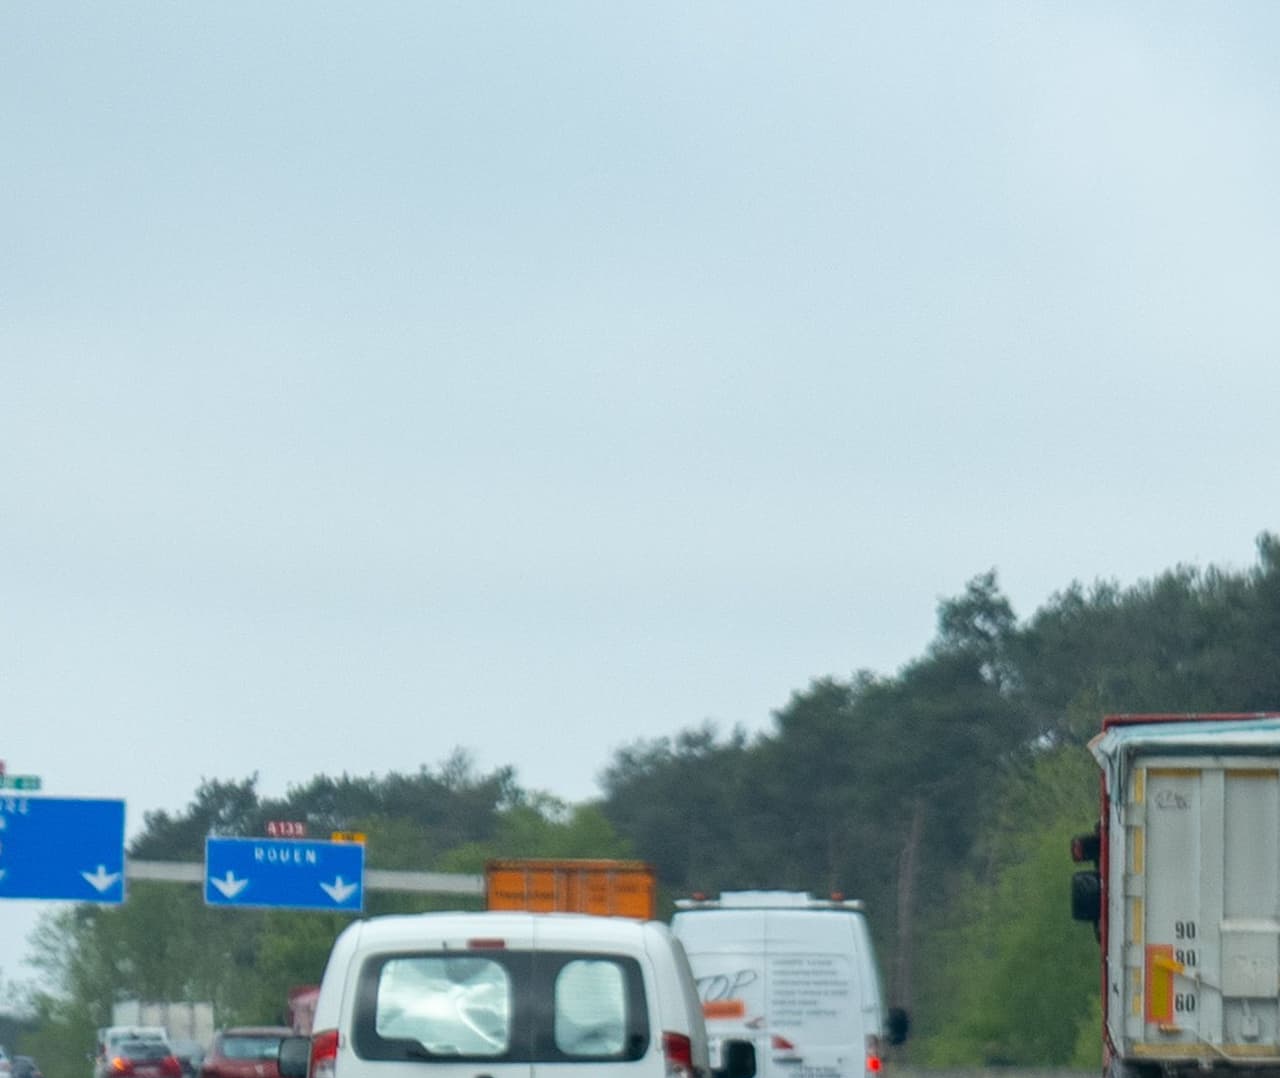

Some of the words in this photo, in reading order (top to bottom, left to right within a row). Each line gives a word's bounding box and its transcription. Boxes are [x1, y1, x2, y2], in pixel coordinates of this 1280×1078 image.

[254, 847, 318, 864] ROUEN
[1175, 920, 1196, 939] 90
[1175, 994, 1196, 1013] 60
